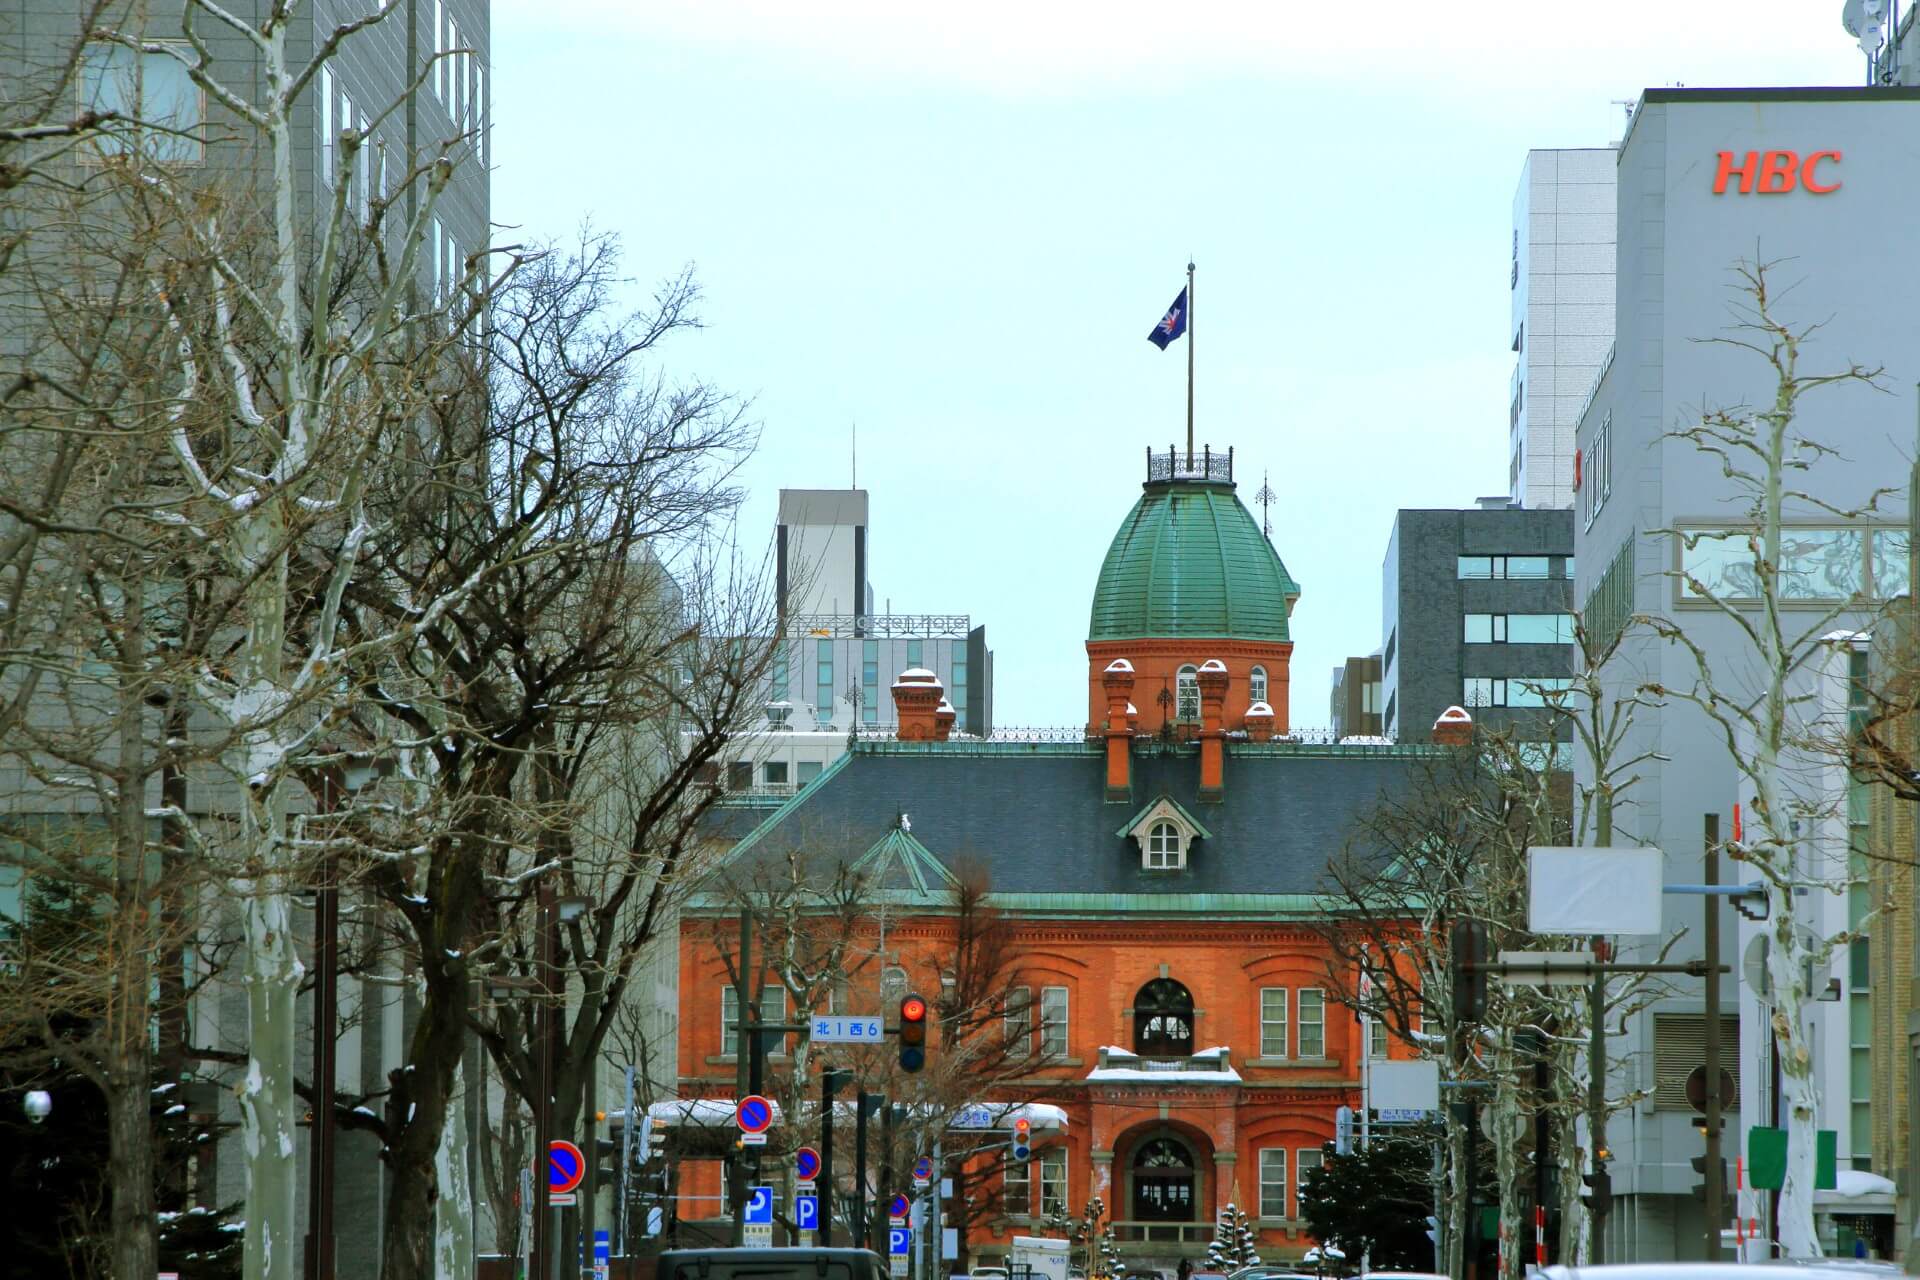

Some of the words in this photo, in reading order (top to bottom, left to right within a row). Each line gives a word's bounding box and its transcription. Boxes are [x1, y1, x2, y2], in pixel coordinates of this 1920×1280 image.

[1712, 150, 1842, 194] HBC
[816, 1021, 878, 1037] 北1西6
[745, 1190, 766, 1221] P
[800, 1199, 815, 1227] P
[890, 1231, 905, 1252] P
